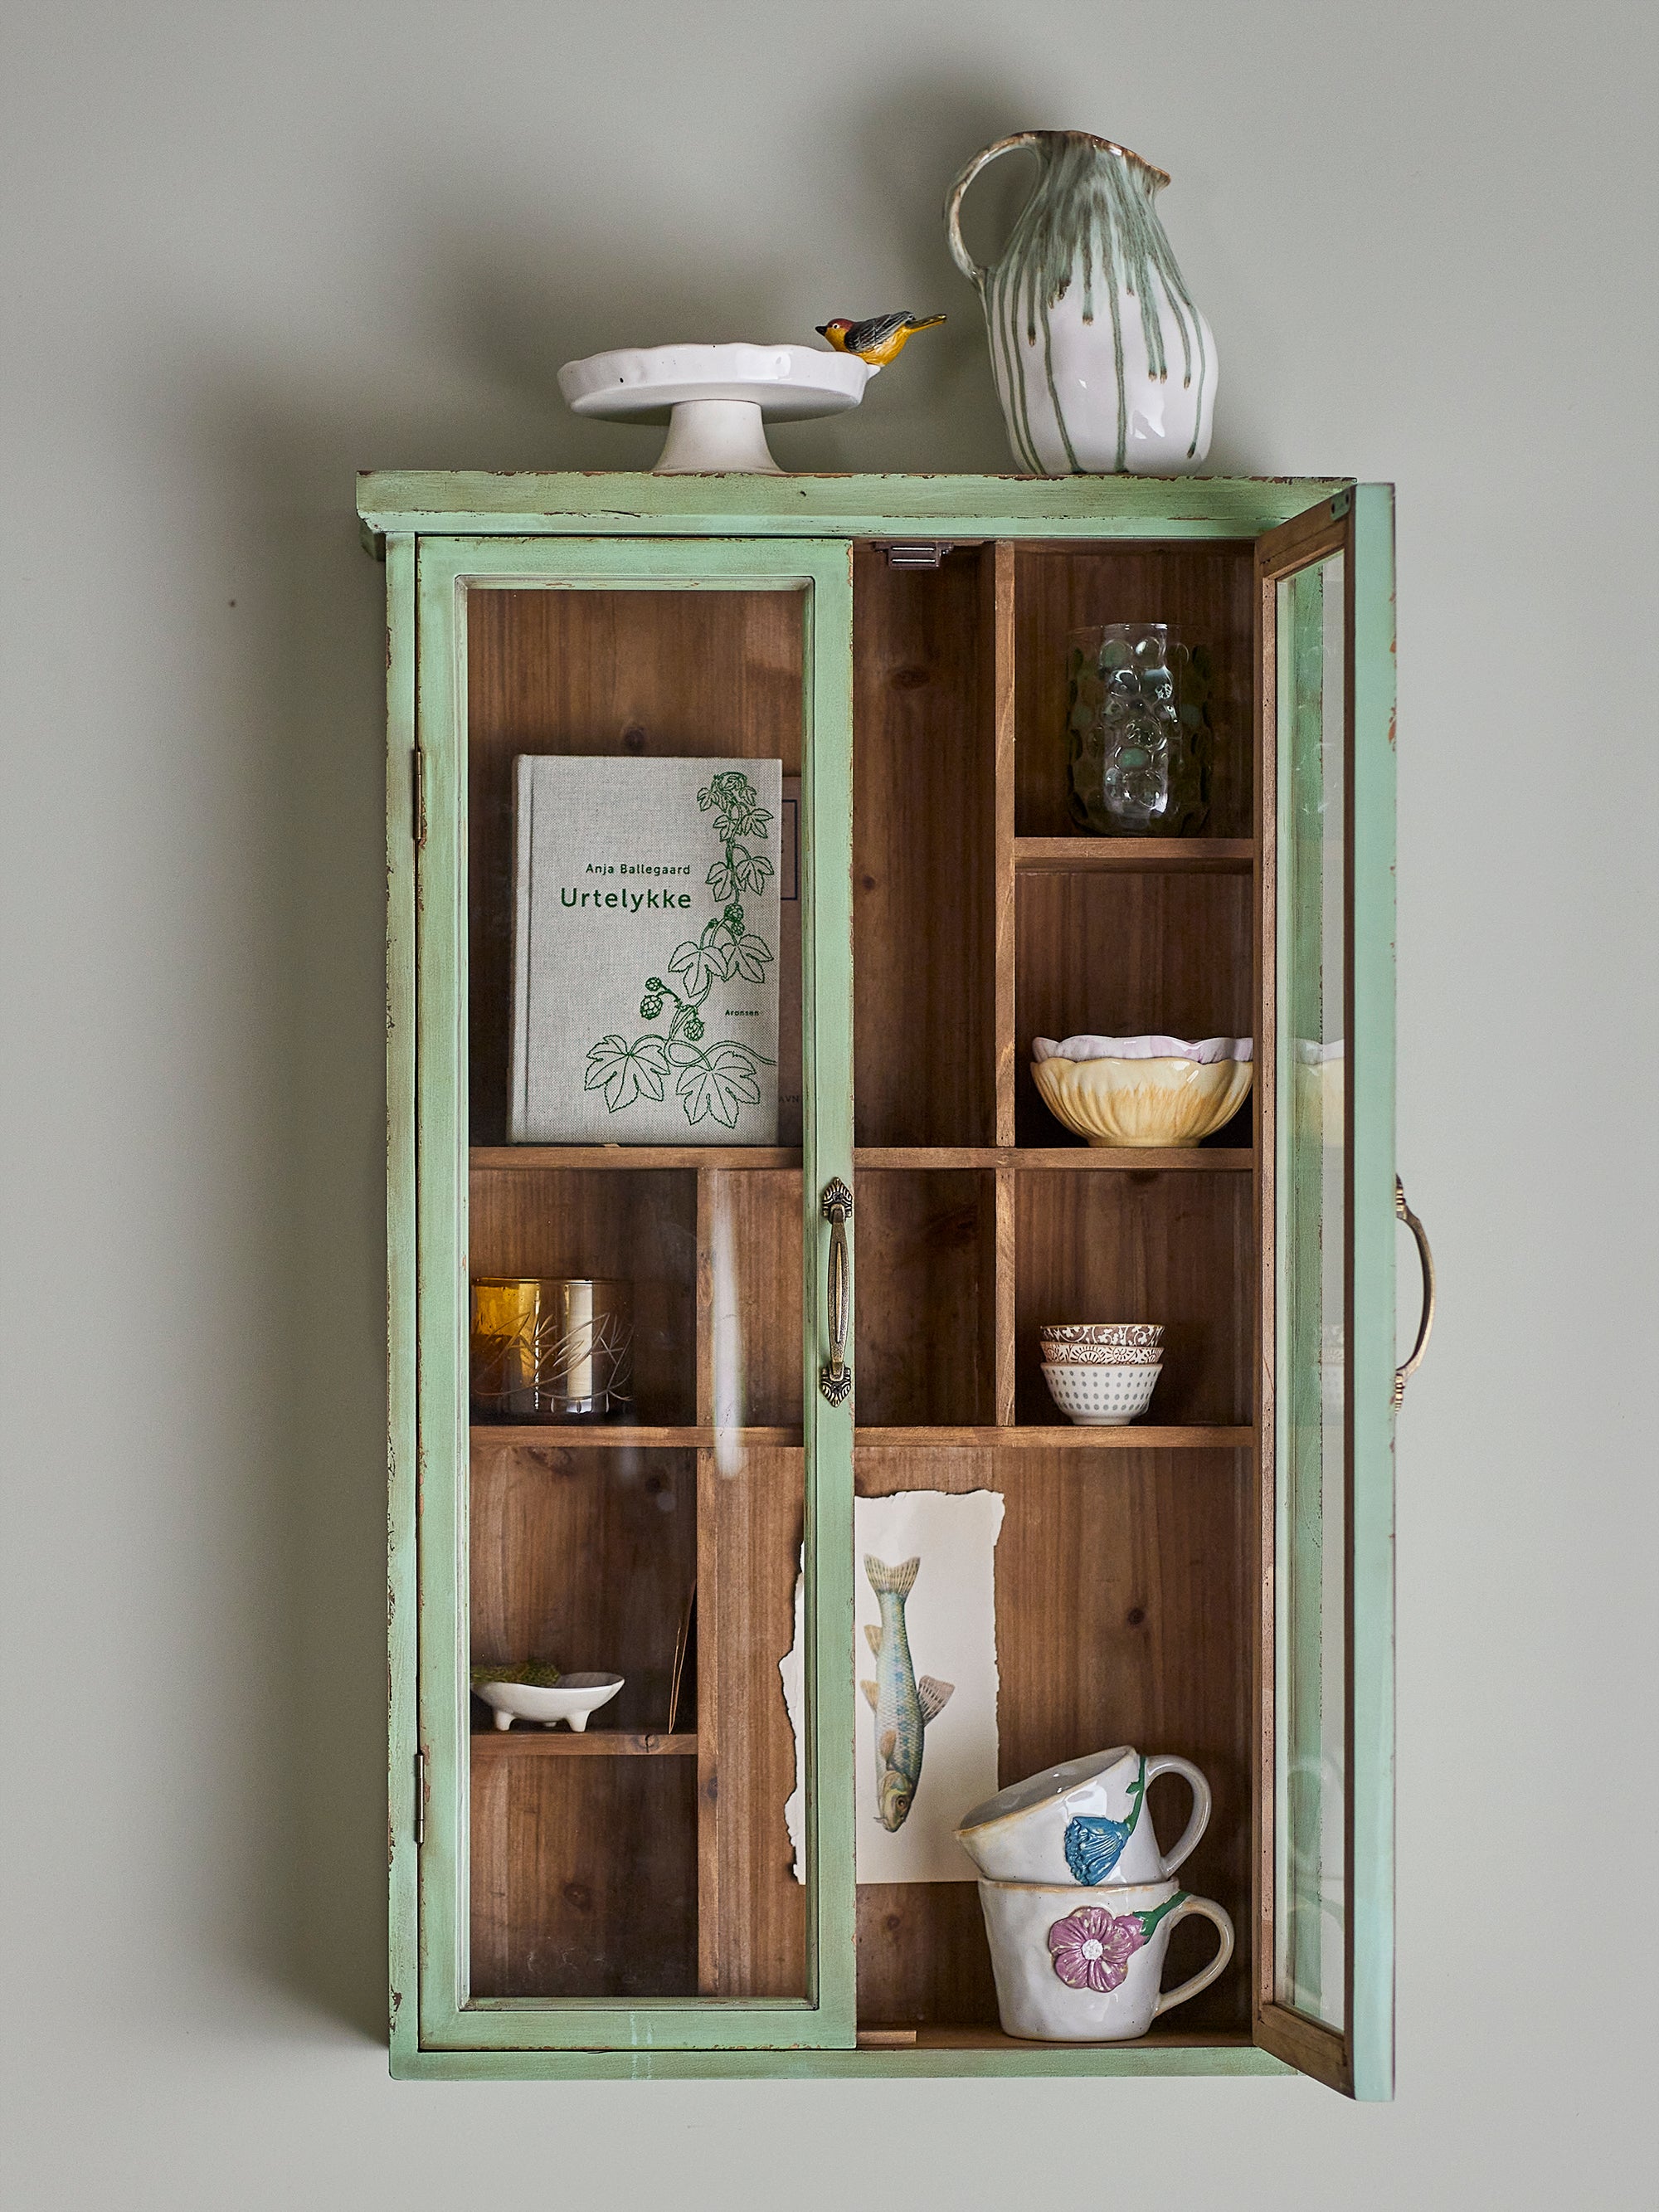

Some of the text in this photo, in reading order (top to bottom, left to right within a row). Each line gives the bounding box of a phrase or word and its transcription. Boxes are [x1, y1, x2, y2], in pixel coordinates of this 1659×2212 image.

[586, 863, 691, 876] Anja Ballegaard
[561, 887, 692, 913] Urtelykke
